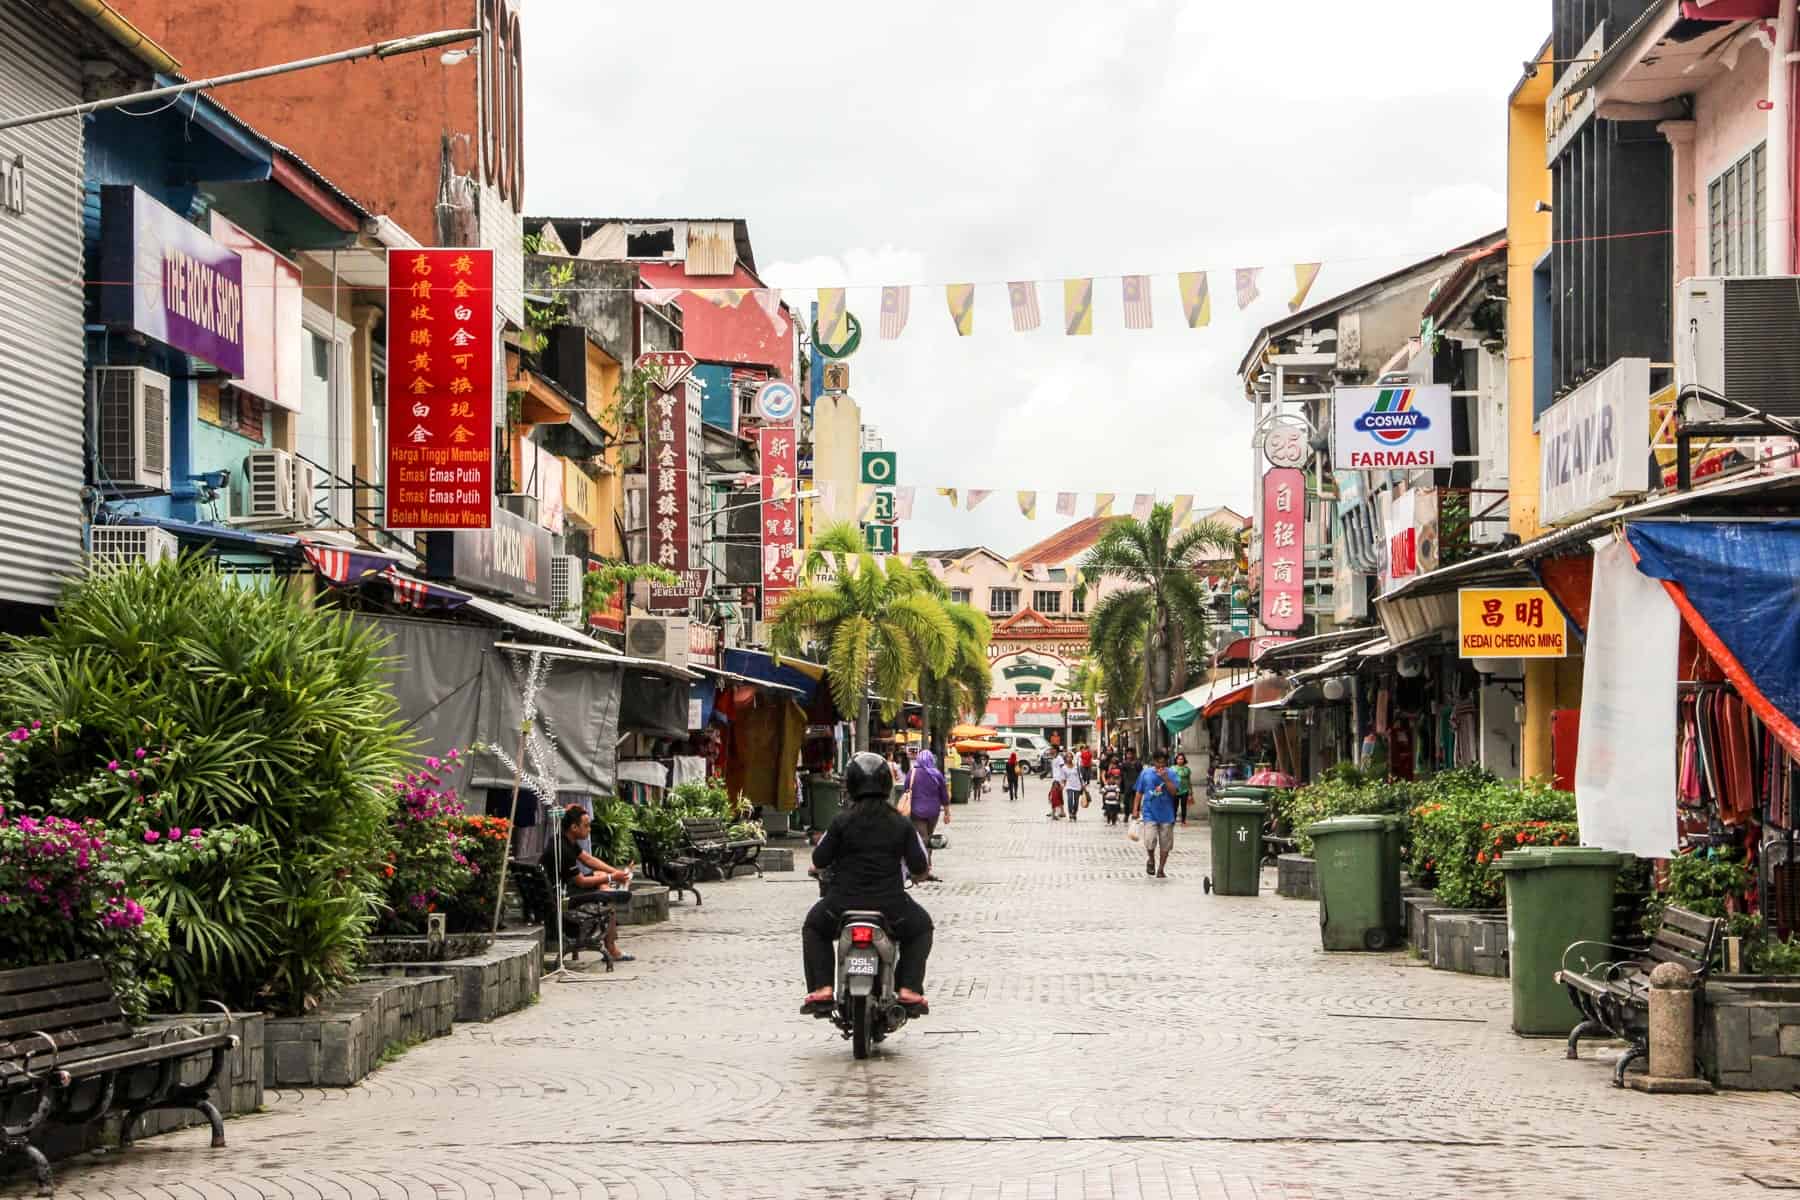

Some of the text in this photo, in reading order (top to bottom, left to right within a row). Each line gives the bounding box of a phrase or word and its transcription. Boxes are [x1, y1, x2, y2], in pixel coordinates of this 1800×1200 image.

[165, 246, 241, 345] THE ROCK SHOP
[1365, 415, 1418, 427] COSWAY
[392, 448, 490, 464] Harga Tinggi Membeli
[1351, 450, 1434, 467] FARMASI
[430, 467, 454, 482] Emas
[457, 467, 480, 482] Putih
[429, 488, 454, 504] Emas
[456, 488, 480, 504] Putih
[392, 508, 487, 528] Boleh Menukar Wang
[1482, 598, 1543, 628] 昌明
[1463, 633, 1562, 648] KEDAI CHEONG MING
